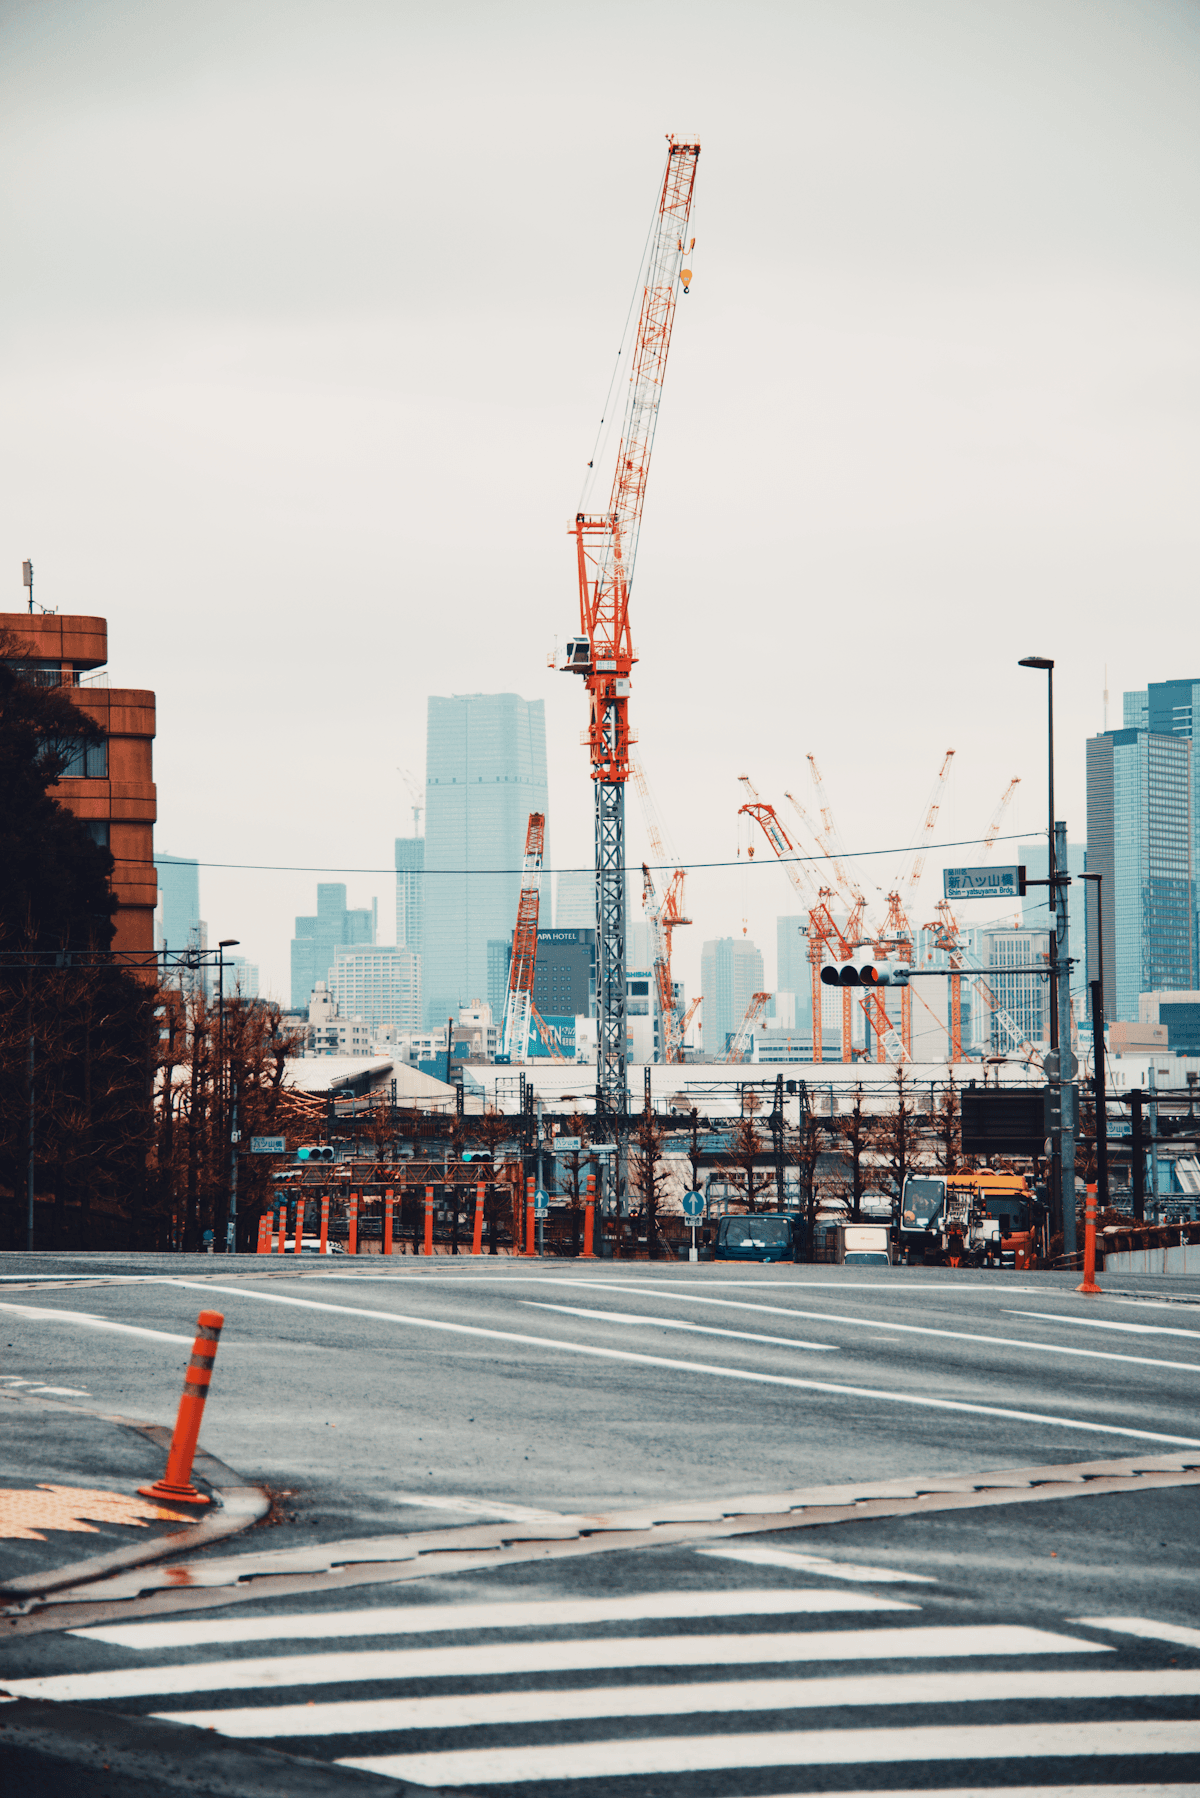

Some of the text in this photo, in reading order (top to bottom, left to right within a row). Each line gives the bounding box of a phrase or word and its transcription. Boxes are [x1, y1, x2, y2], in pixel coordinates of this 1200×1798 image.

[948, 874, 1014, 888] 新八ツ山橋
